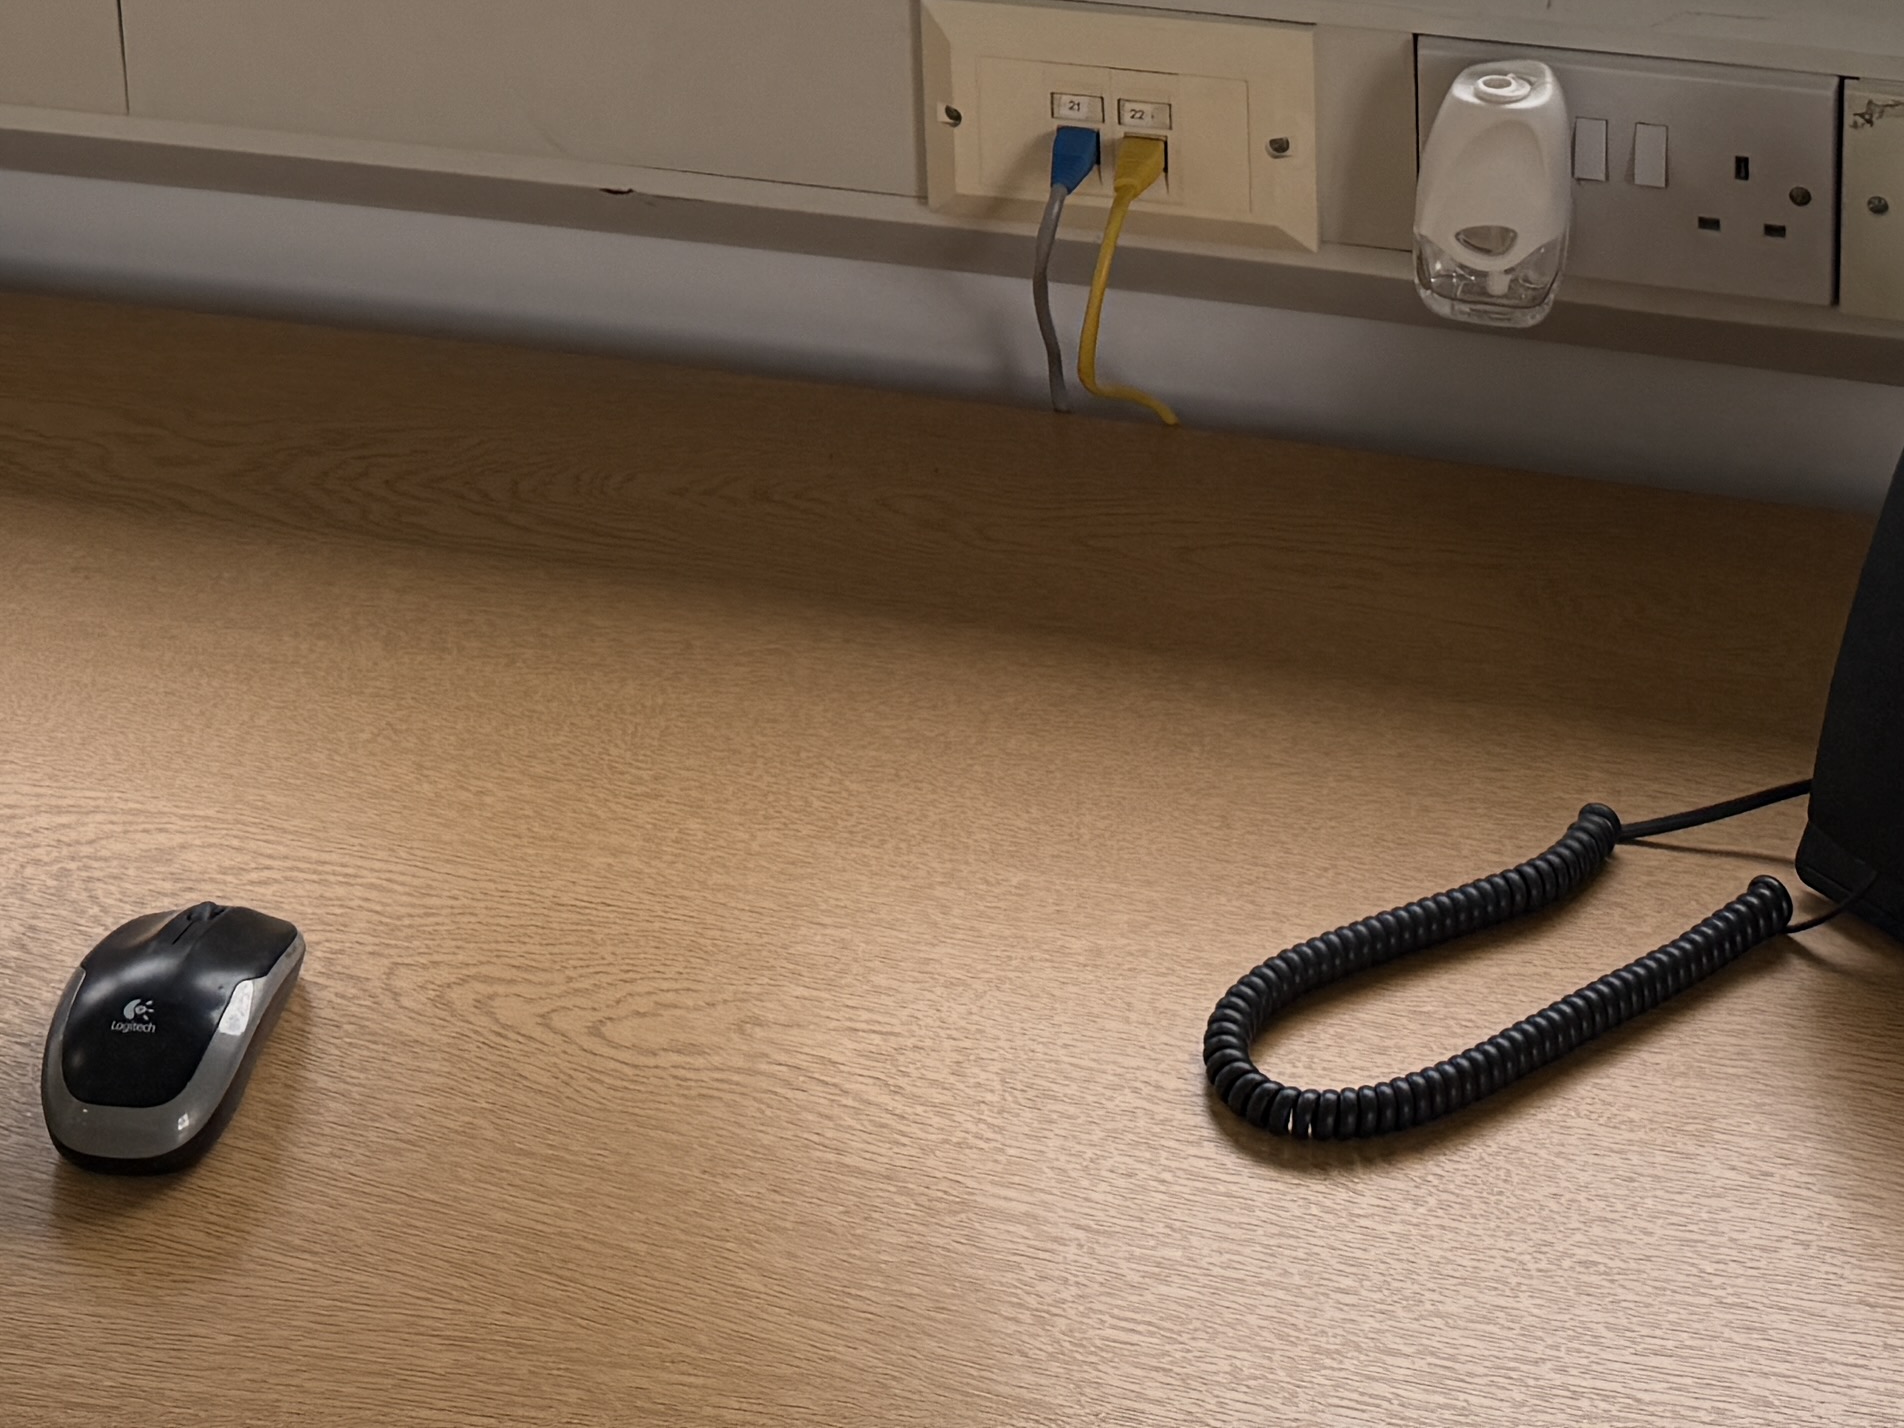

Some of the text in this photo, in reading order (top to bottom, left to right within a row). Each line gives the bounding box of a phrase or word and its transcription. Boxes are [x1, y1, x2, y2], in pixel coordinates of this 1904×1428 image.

[1068, 100, 1081, 111] 21
[1130, 109, 1145, 120] 22
[111, 1020, 156, 1034] Logitech
